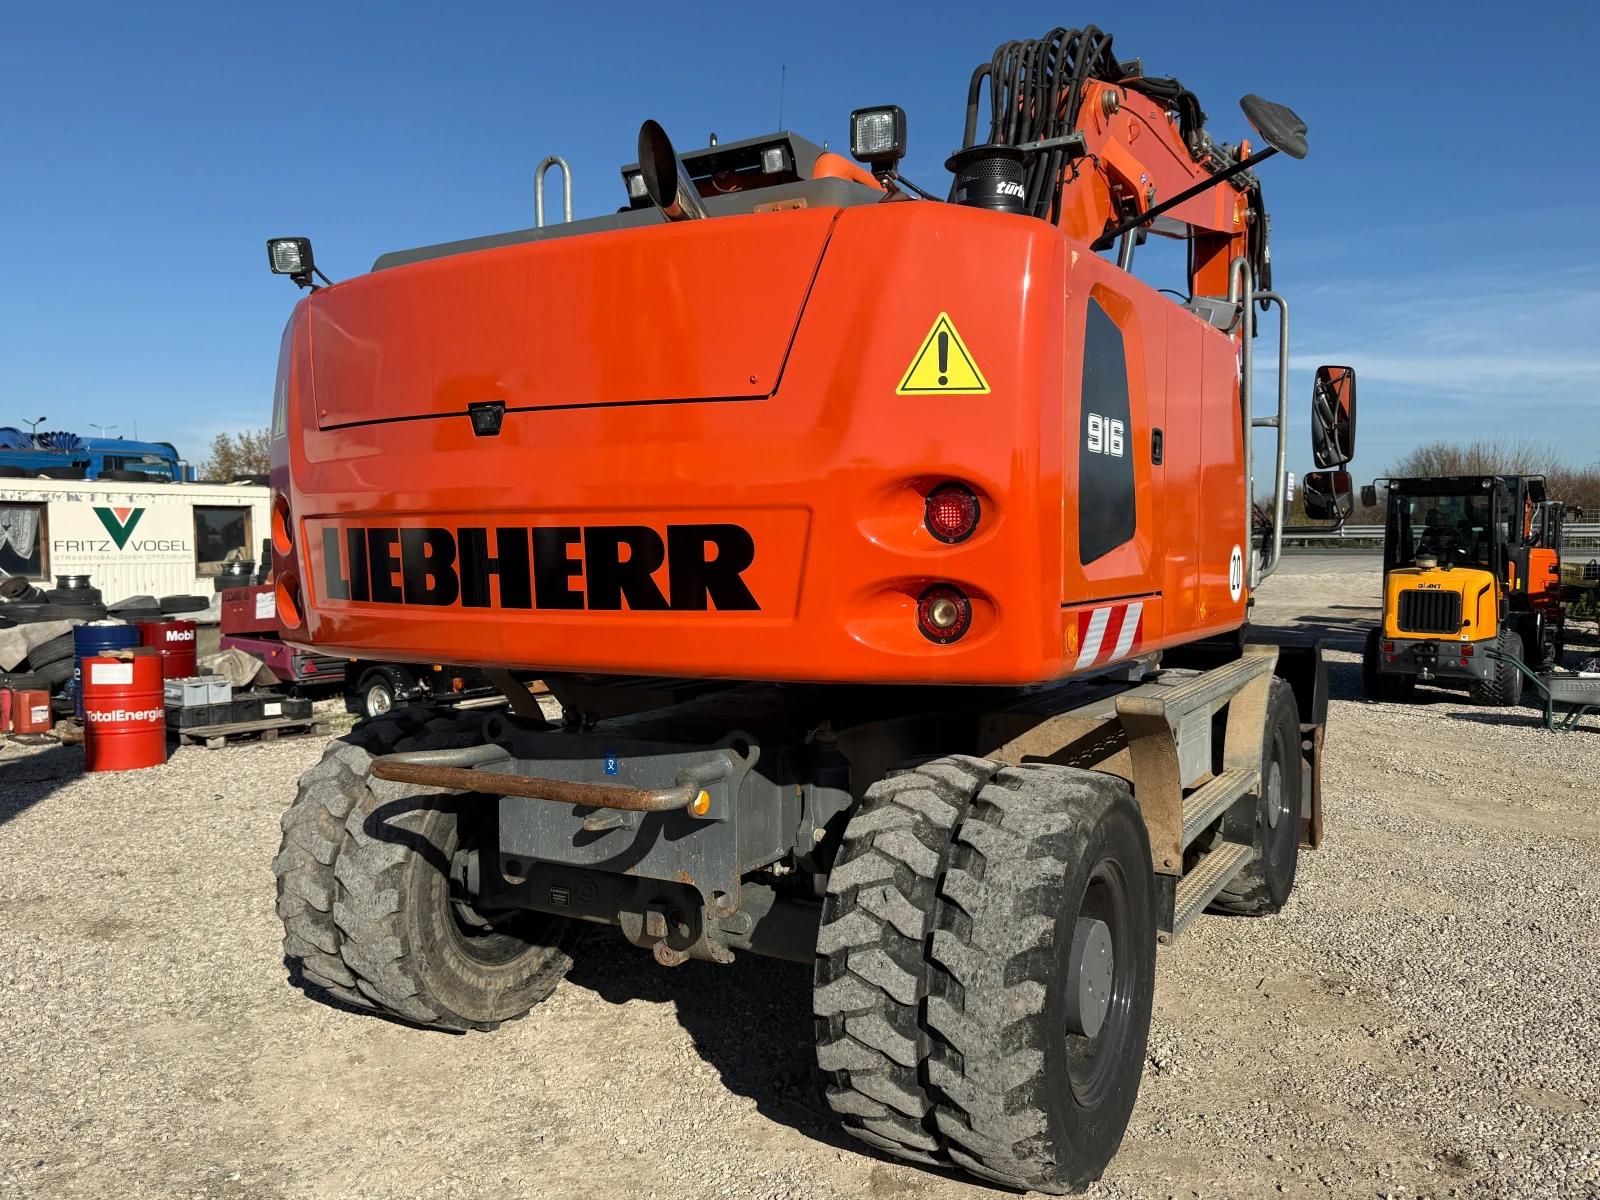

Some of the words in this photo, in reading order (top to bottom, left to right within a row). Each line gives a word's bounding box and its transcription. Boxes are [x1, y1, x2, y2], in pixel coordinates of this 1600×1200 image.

[1087, 412, 1124, 457] 916
[54, 540, 111, 552] FRITZ
[131, 540, 192, 552] VOGEL
[54, 553, 117, 561] STRASSENBAU
[322, 523, 762, 611] LIEBHERR
[1231, 553, 1241, 591] 20
[166, 629, 195, 642] Mobil
